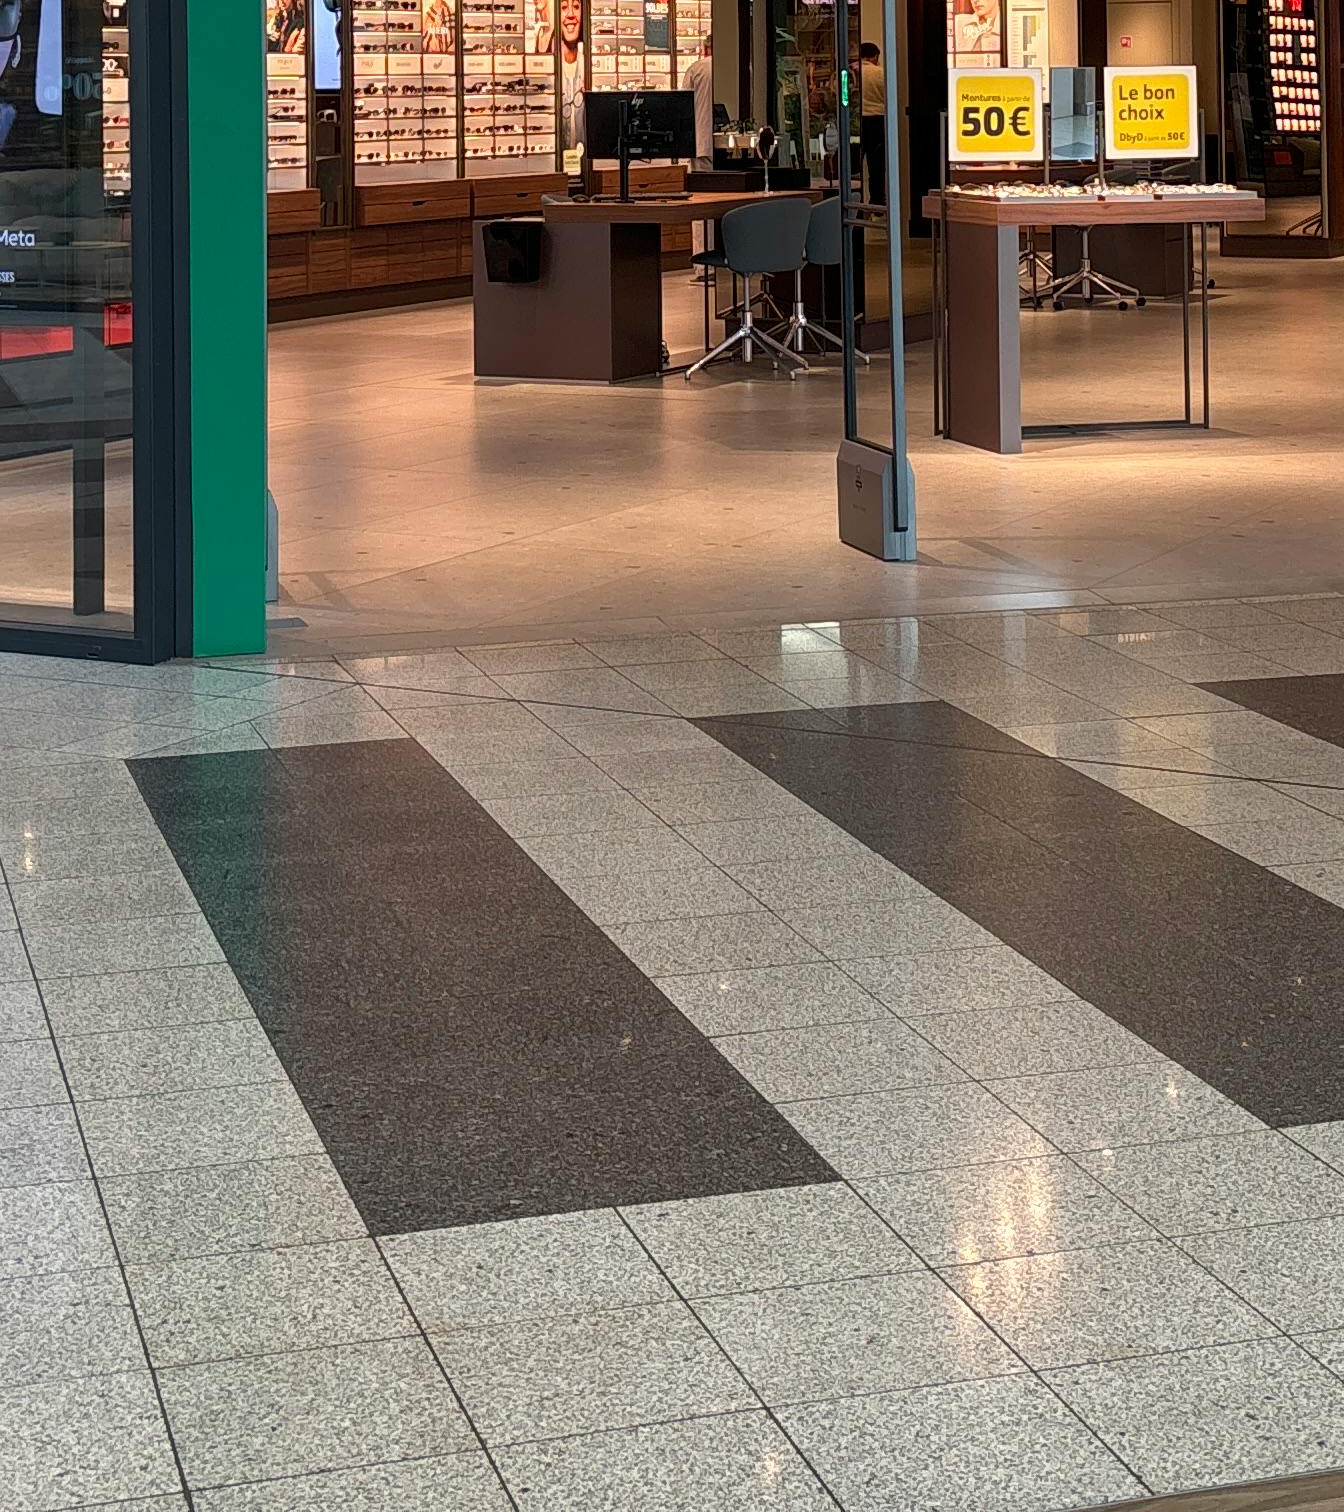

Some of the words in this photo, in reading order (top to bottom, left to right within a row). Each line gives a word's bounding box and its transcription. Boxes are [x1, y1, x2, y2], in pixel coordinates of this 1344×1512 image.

[1118, 85, 1139, 101] Le
[1143, 84, 1175, 100] bon
[1118, 104, 1165, 121] choix
[1119, 132, 1143, 144] DbyD
